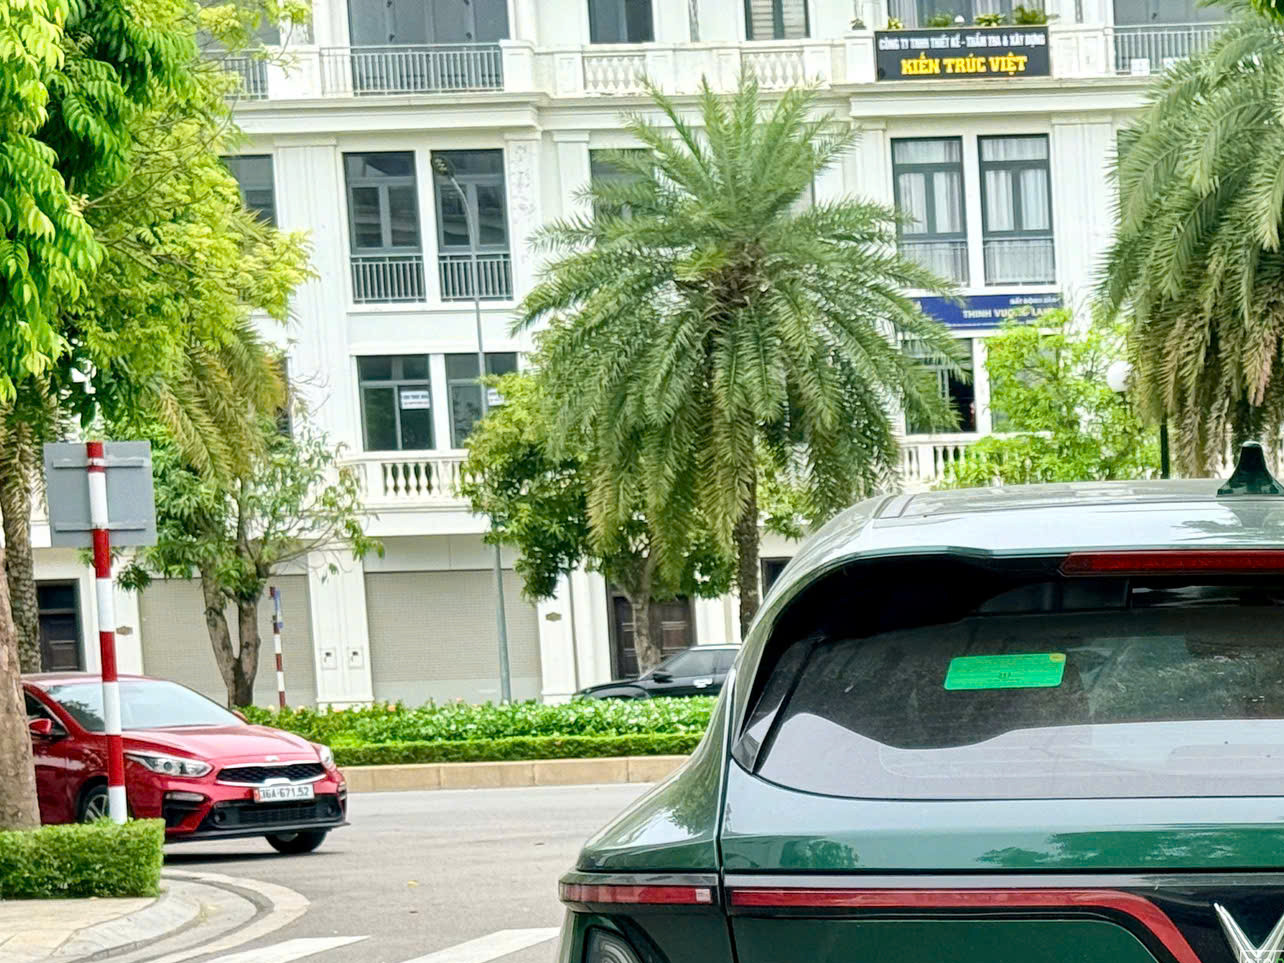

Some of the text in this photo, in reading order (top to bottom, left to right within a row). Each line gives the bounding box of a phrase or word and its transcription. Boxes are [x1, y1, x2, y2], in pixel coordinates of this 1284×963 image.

[901, 51, 1028, 76] KIẾN TRÚC VIỆT
